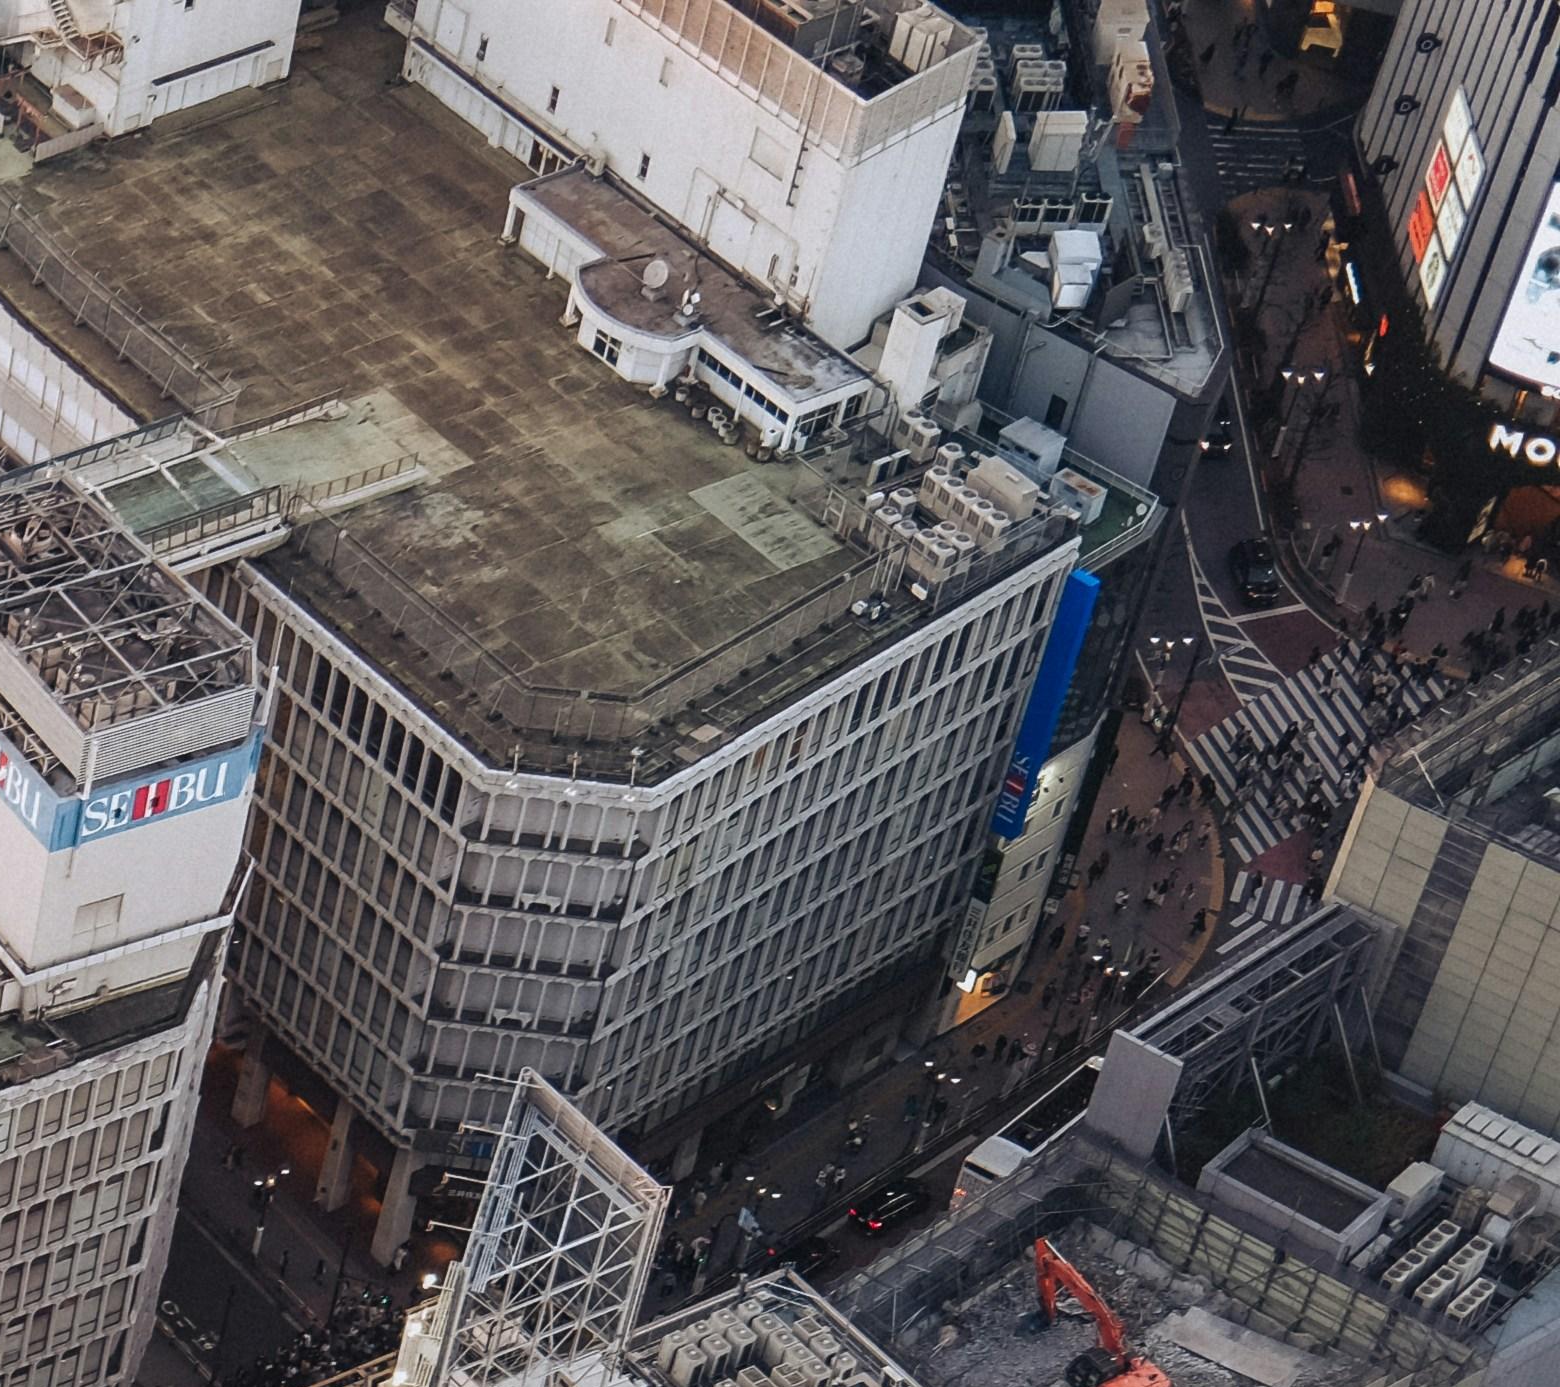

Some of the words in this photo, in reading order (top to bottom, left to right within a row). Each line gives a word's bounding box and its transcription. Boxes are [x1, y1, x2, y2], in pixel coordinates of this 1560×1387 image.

[1488, 423, 1560, 457] MO
[82, 762, 228, 836] SEIBU
[996, 755, 1031, 824] SEIBU
